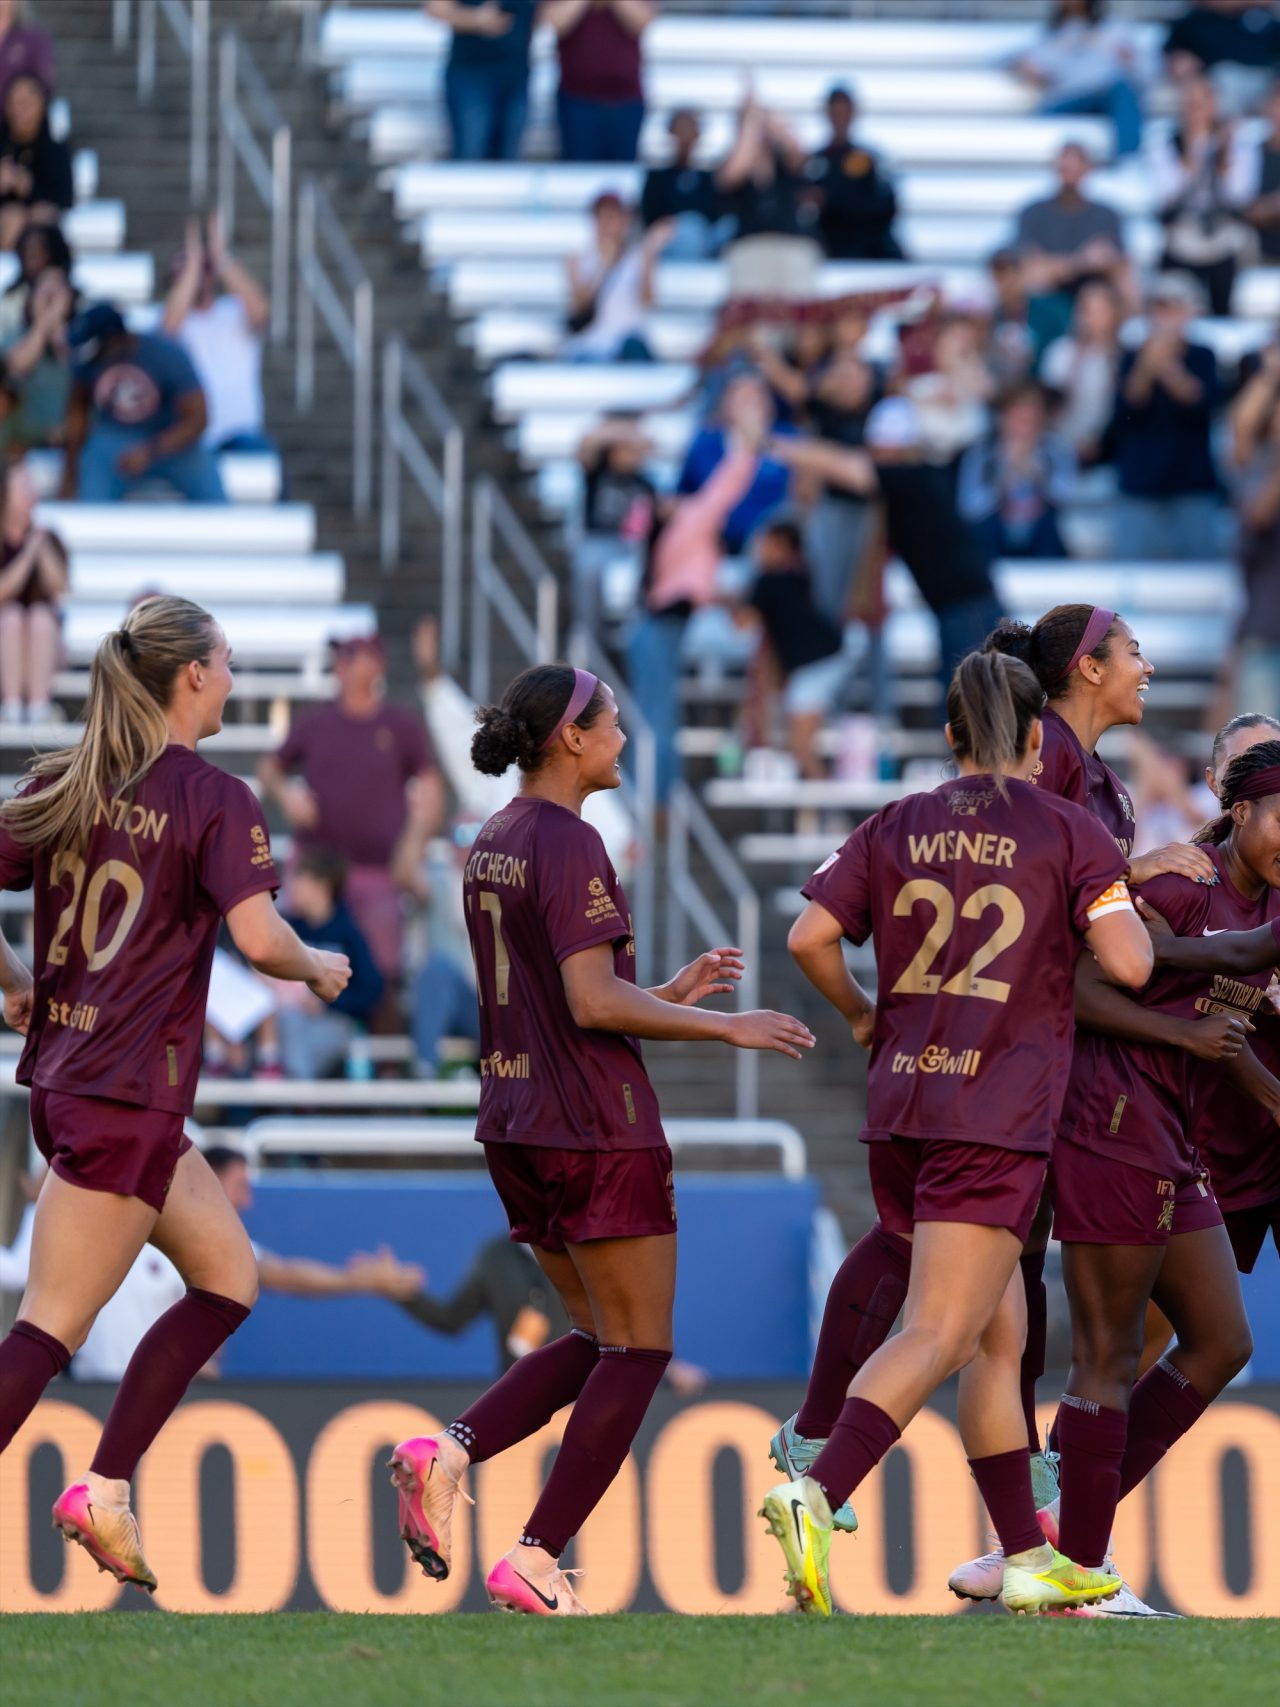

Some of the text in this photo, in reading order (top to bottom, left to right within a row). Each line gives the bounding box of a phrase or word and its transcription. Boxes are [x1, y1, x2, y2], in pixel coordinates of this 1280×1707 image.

[908, 830, 1017, 869] WISNER
[47, 850, 144, 972] 20
[890, 878, 1025, 1004] 22
